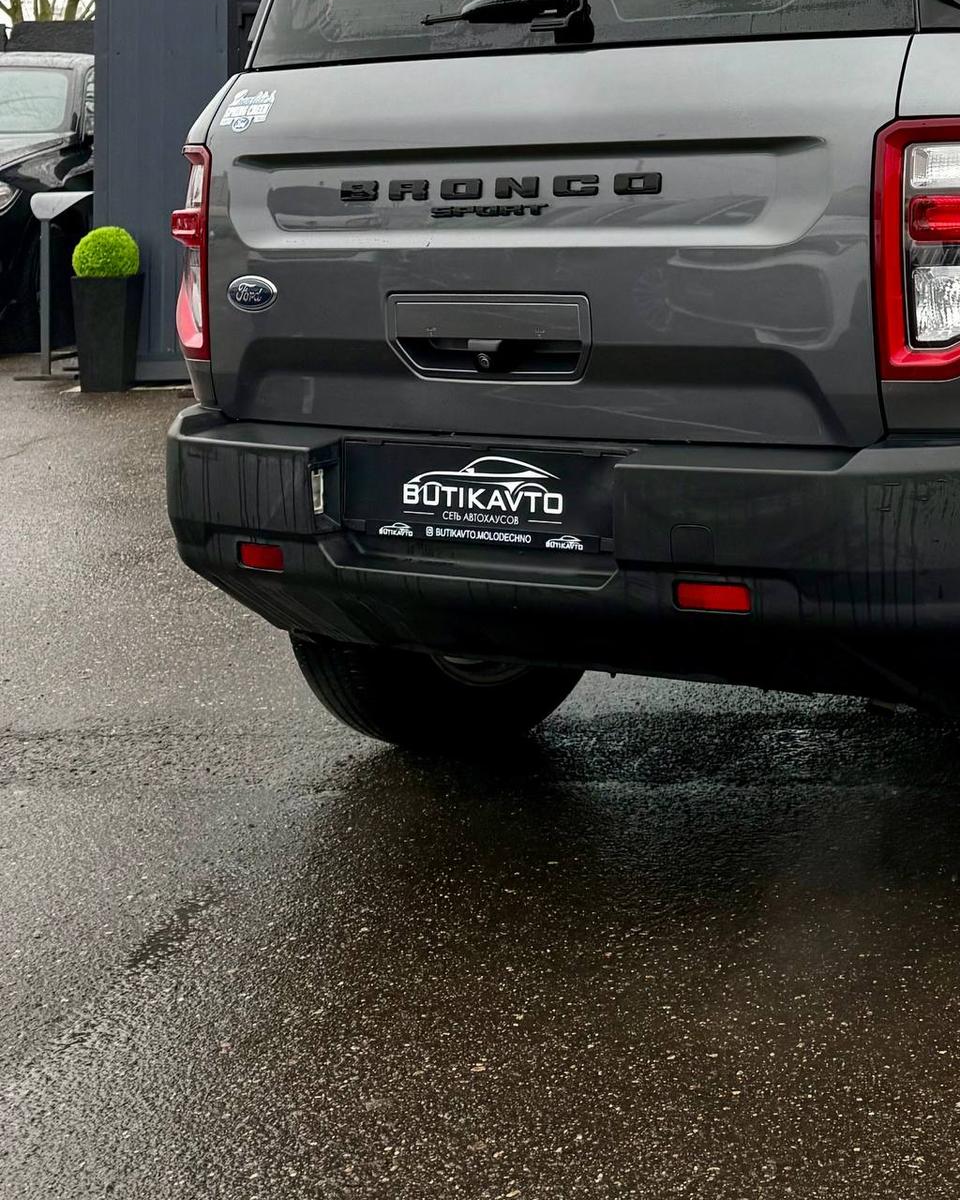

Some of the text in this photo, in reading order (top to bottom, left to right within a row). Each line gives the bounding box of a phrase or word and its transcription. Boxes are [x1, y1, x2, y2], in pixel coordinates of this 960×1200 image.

[340, 171, 663, 201] BRONCO
[430, 202, 549, 218] SPORT
[235, 282, 263, 302] Ford
[403, 483, 563, 515] BUTIKAVTO
[442, 510, 520, 526] СЕТЬ АВТОХАУСОВ
[378, 527, 414, 538] BUTIKAVTO
[435, 527, 532, 544] BUTIKAVTO.MOLODECHNO
[545, 541, 584, 551] BUTIKAVTO
